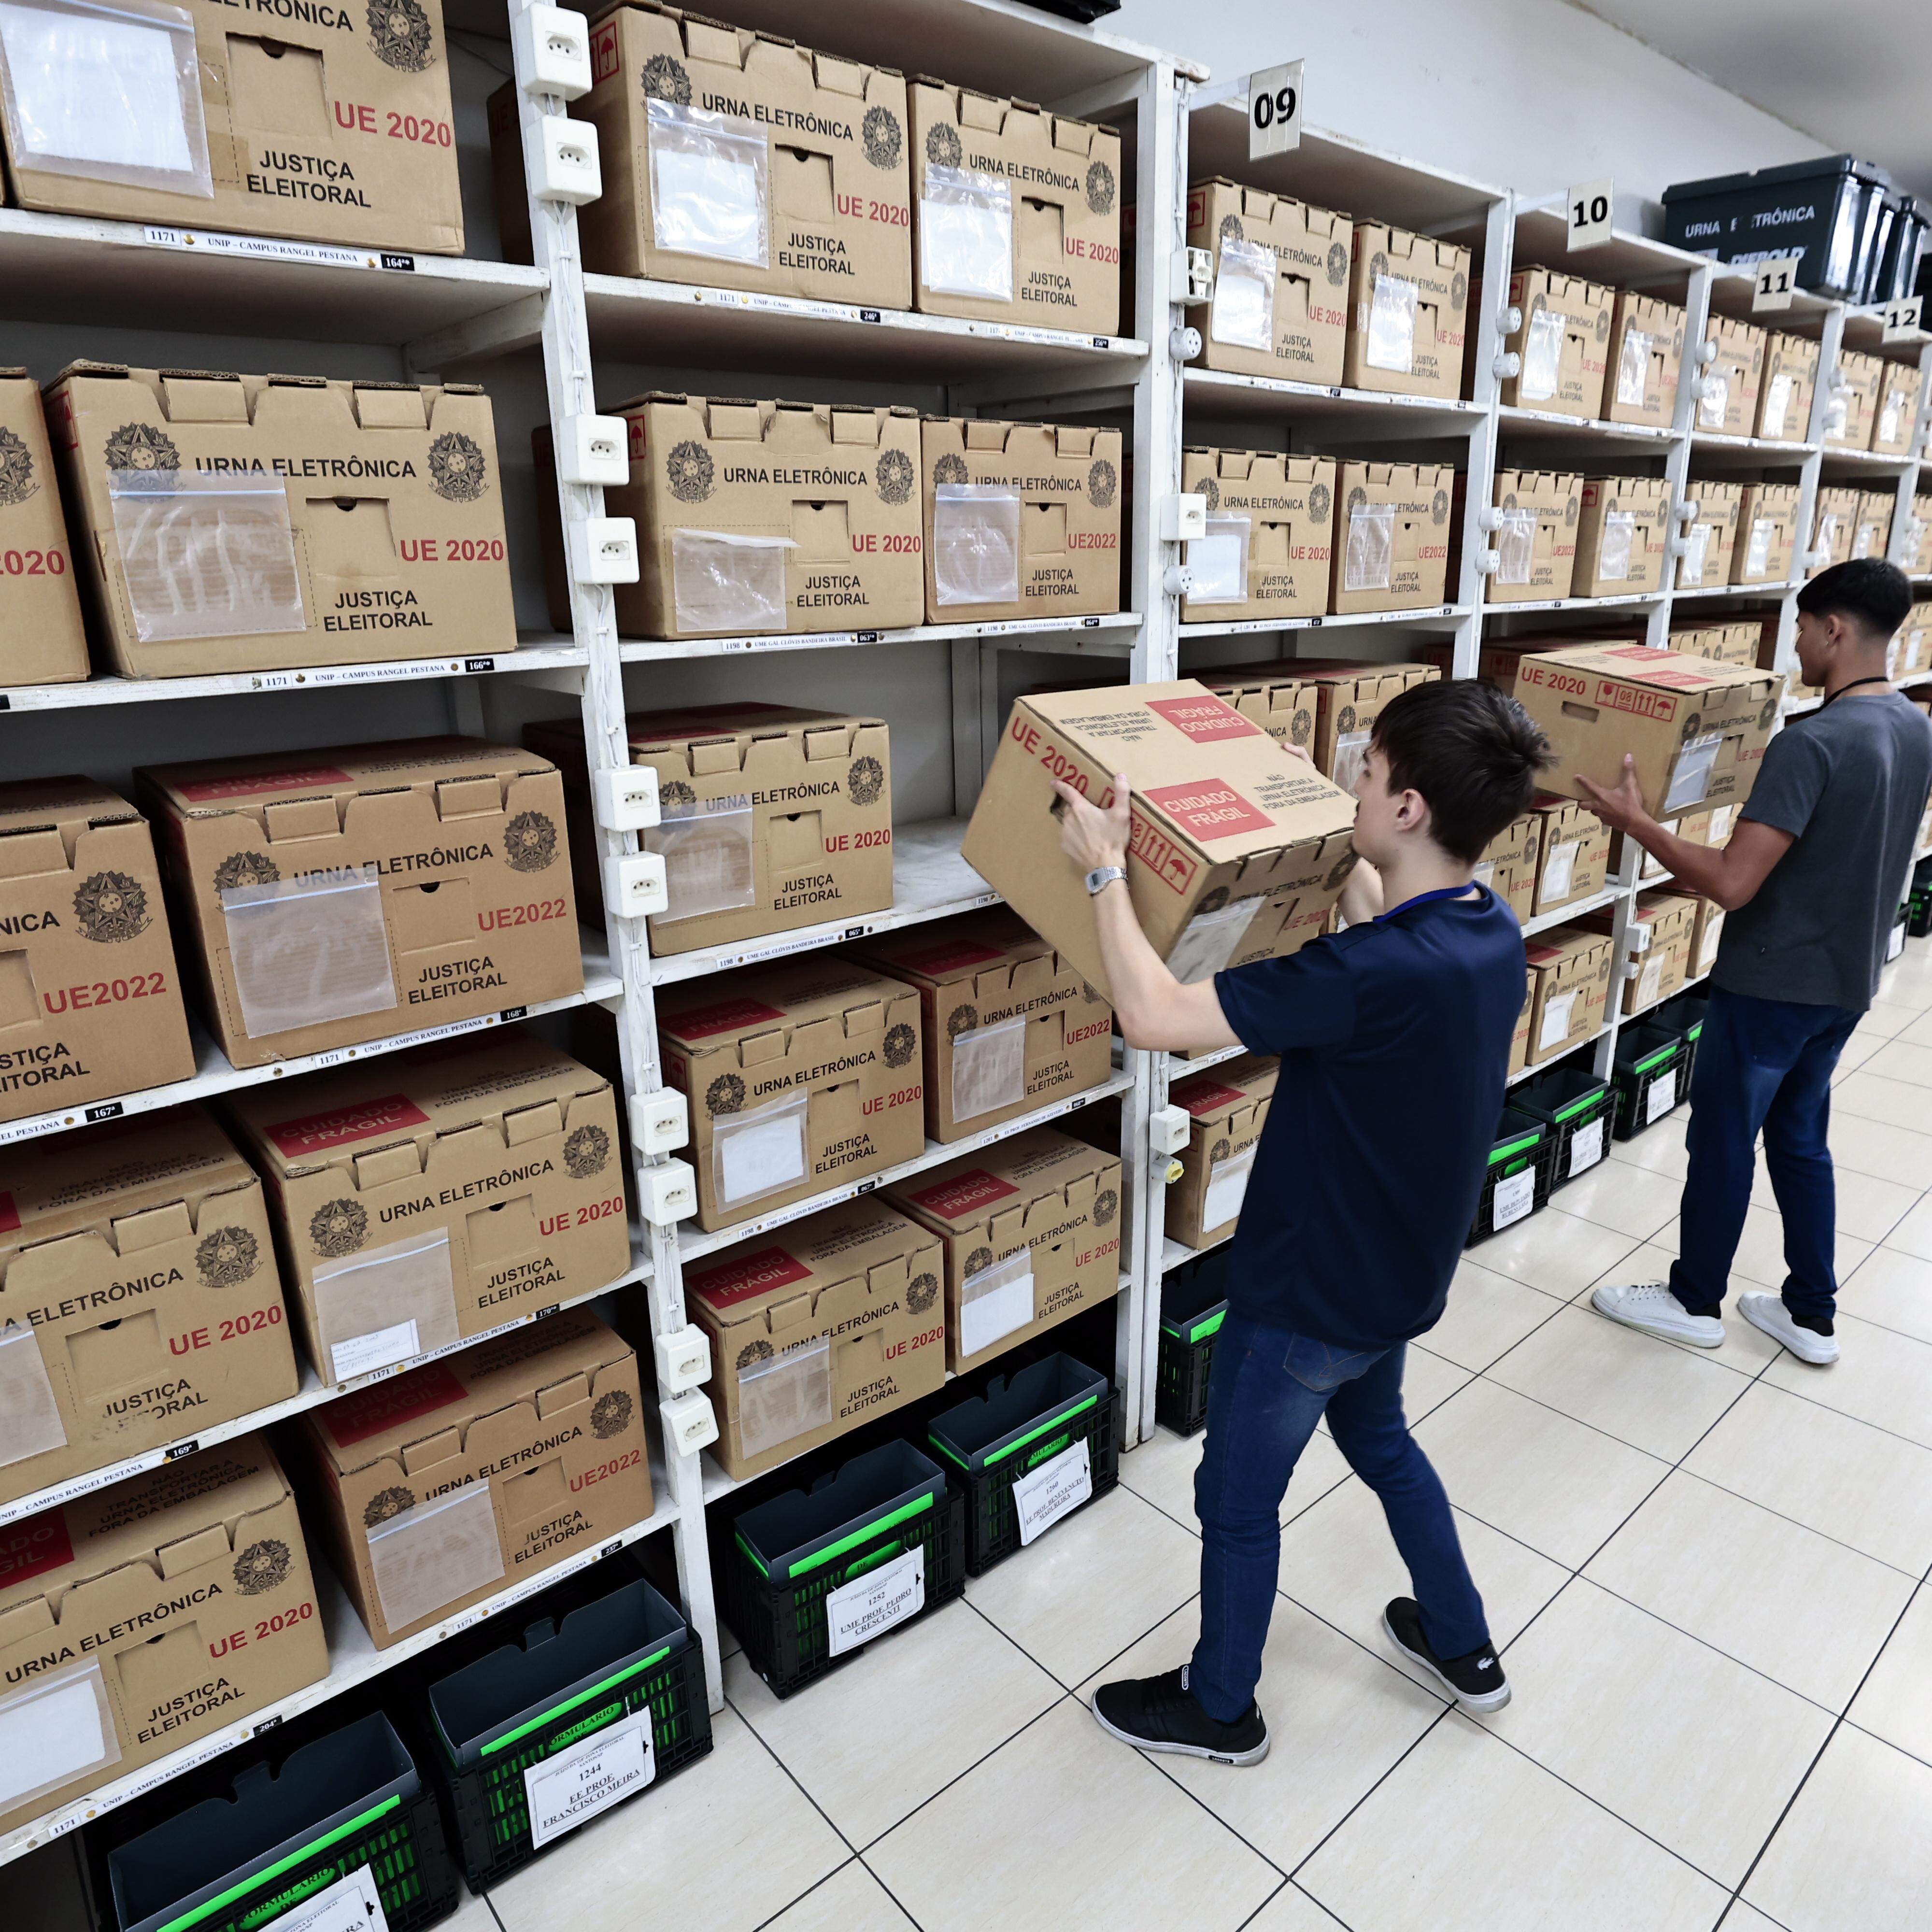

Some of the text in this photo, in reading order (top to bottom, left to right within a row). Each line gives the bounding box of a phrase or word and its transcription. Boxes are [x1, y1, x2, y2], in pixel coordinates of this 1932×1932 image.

[703, 93, 853, 141] URNA ELETRÔNICA
[1254, 87, 1295, 128] 09
[335, 100, 451, 147] UE 2020
[260, 151, 354, 181] JUSTIÇA
[970, 154, 1079, 191] URNA ELETRÔNICA
[246, 174, 371, 208] ELEITORAL
[838, 194, 909, 227] UE 2020
[1574, 197, 1607, 227] 10
[151, 231, 174, 242] 1171
[1685, 220, 1720, 238] URNA
[240, 242, 277, 252] CAMPUS
[280, 246, 317, 257] RANGEL
[319, 251, 357, 261] PESTANA
[788, 233, 846, 255] JUSTIÇA
[1065, 237, 1119, 266] UE 2020
[780, 252, 854, 275] ELEITORAL
[1029, 271, 1071, 290] JUSTIÇA
[1760, 272, 1788, 294] 11
[1022, 287, 1077, 306] ELEITORAL
[1309, 306, 1347, 326] UE 2020
[1889, 309, 1916, 328] 12
[1282, 334, 1311, 349] JUSTIÇA
[1277, 347, 1314, 363] ELEITORAL
[196, 455, 416, 477] URNA ELETRÔNICA
[724, 467, 867, 485] URNA ELETRÔNICA
[975, 477, 1081, 491] URNA ELETRÔNICA
[1224, 496, 1303, 510] URNA ELETRÔNICA
[401, 540, 504, 562] UE 2020
[853, 534, 922, 553] UE 2020
[1068, 533, 1118, 549] UE2022
[1291, 545, 1330, 561] UE 2020
[1418, 546, 1447, 559] UE2022
[806, 576, 860, 590] JUSTIÇA
[1033, 569, 1073, 582] JUSTIÇA
[1262, 576, 1293, 588] JUSTIÇA
[335, 590, 417, 609] JUSTIÇA
[797, 593, 869, 607] ELEITORAL
[1026, 584, 1079, 596] ELEITORAL
[1256, 589, 1297, 598] ELEITORAL
[324, 611, 432, 631] ELEITORAL
[377, 668, 410, 676] RANGEL
[1522, 667, 1587, 695] UE 2020
[1179, 715, 1245, 731] CUIDADO
[1010, 717, 1089, 795] UE 2020
[706, 781, 839, 811] URNA ELETRÔNICA
[1253, 779, 1307, 793] TRANSPORTAR
[1260, 793, 1284, 801] URNA
[1164, 791, 1236, 813] CUIDADO
[1263, 800, 1286, 810] FORA
[1297, 790, 1341, 804] EMBALAGEM
[1187, 807, 1250, 828] FRÁGIL
[825, 829, 891, 852] UE 2020
[294, 844, 493, 888] URNA ELETRÔNICA
[782, 874, 834, 893] JUSTIÇA
[774, 888, 841, 910] ELEITORAL
[477, 899, 567, 932] UE2022
[792, 940, 816, 949] BANDEIRA
[419, 956, 494, 982] JUSTIÇA
[43, 972, 167, 1014] UE2022
[409, 973, 507, 1004] ELEITORAL
[1066, 1018, 1111, 1047] UE2022
[321, 1054, 339, 1064] 1171
[754, 1051, 876, 1095] URNA ELETRÔNICA
[863, 1085, 922, 1115] UE 2020
[282, 1102, 402, 1137] CUIDADO
[301, 1113, 402, 1144] FRÁGIL
[823, 1134, 870, 1158] JUSTIÇA
[815, 1144, 878, 1174] ELEITORAL
[380, 1160, 554, 1222] URNA ELETRÔNICA
[924, 1176, 991, 1207] CUIDADO
[944, 1183, 998, 1211] FRÁGIL
[540, 1196, 623, 1236] UE 2020
[1075, 1238, 1120, 1267] UE 2020
[487, 1257, 554, 1289] JUSTIÇA
[479, 1270, 565, 1308] ELEITORAL
[170, 1306, 282, 1355] UE 2020
[885, 1326, 944, 1360] UE 2020
[373, 1369, 389, 1379] 1171
[569, 1449, 641, 1492] UE2022
[1047, 1481, 1058, 1494] 1260
[869, 1592, 885, 1605] 1252
[841, 1619, 860, 1634] UME
[886, 1588, 911, 1608] PEDRO
[855, 1605, 900, 1636] CRESCENTI
[6, 1584, 223, 1683] URNA ELETRÔNICA
[209, 1603, 313, 1658] UE 2020
[147, 1678, 229, 1723] JUSTIÇA
[138, 1688, 245, 1744] ELEITORAL
[580, 1763, 601, 1781] 1244
[543, 1769, 640, 1828] FRANCISCO MEIRA
[569, 1791, 583, 1804] EE
